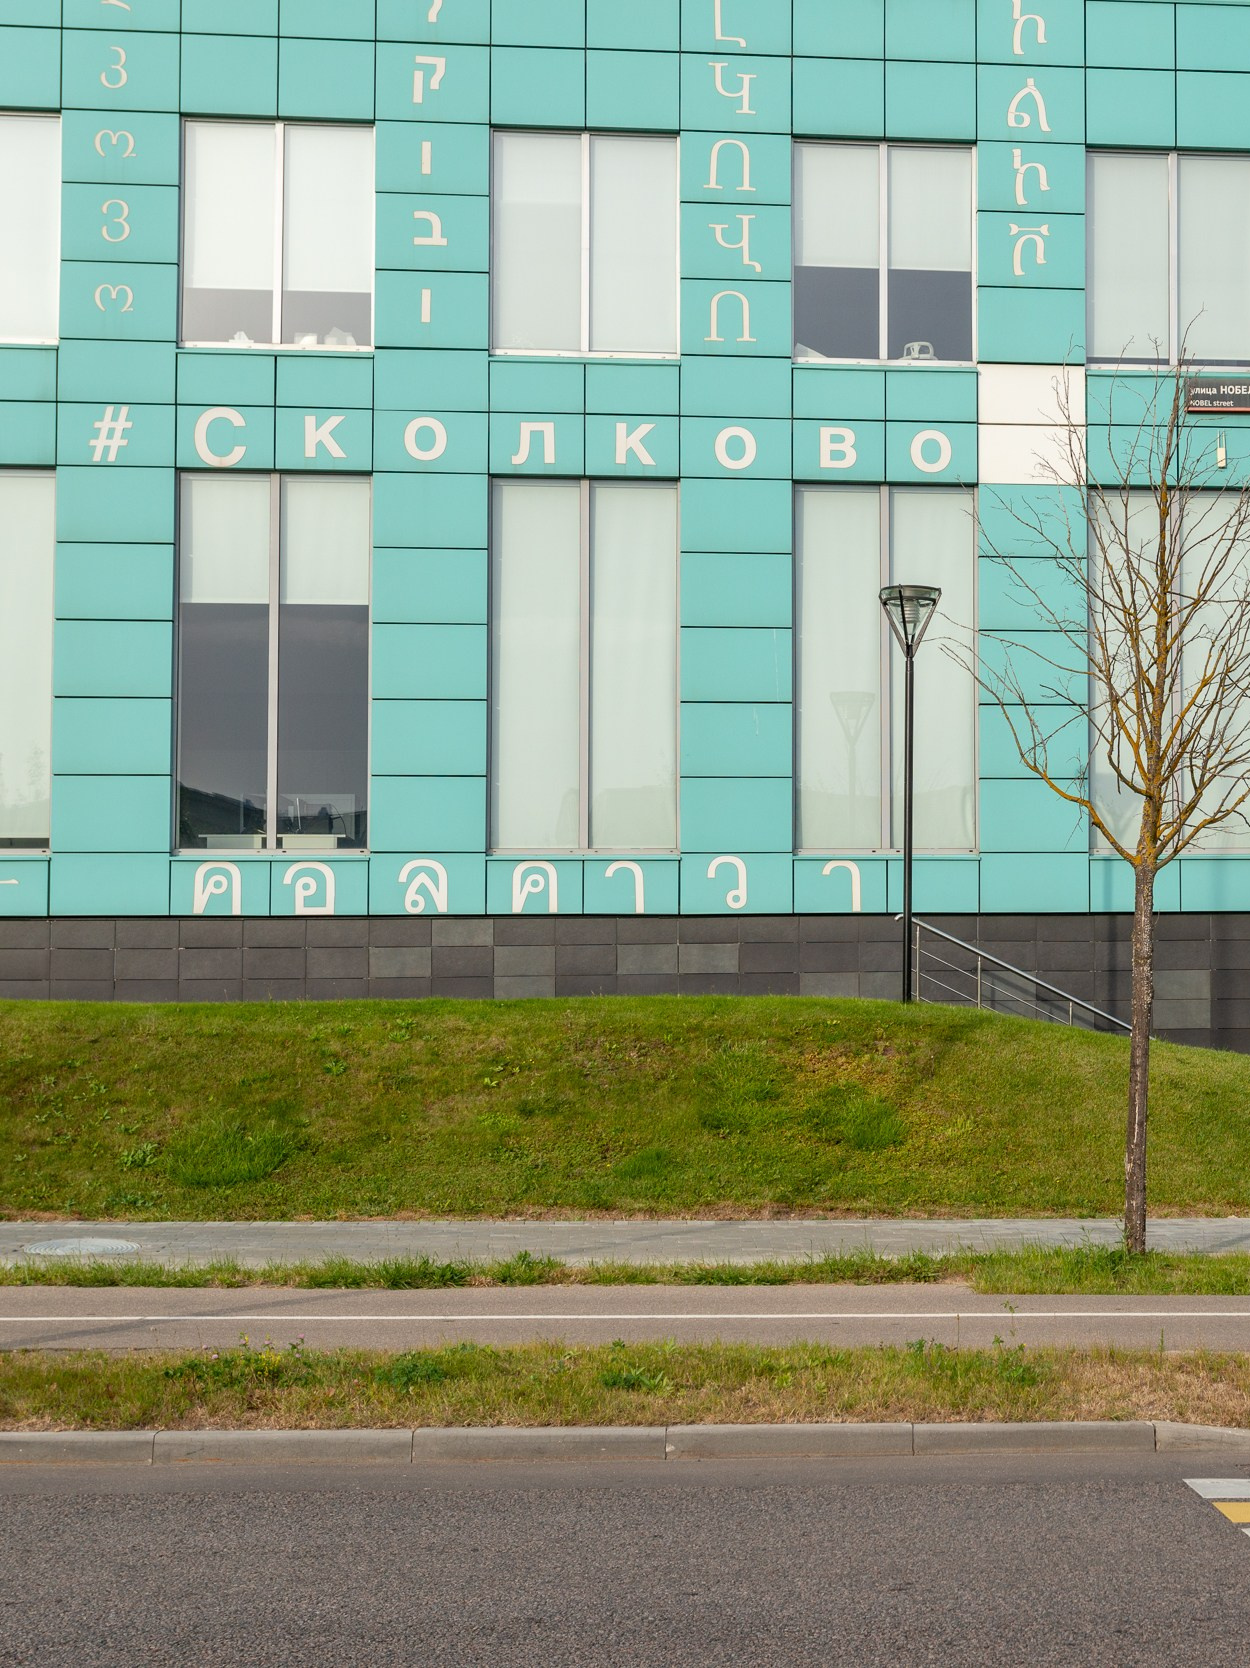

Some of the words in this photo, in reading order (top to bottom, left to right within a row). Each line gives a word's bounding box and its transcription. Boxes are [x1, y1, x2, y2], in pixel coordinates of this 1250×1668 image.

[94, 0, 136, 312] კოვო
[1190, 387, 1217, 395] улица
[1190, 399, 1212, 407] NOBEL
[1213, 399, 1234, 407] street
